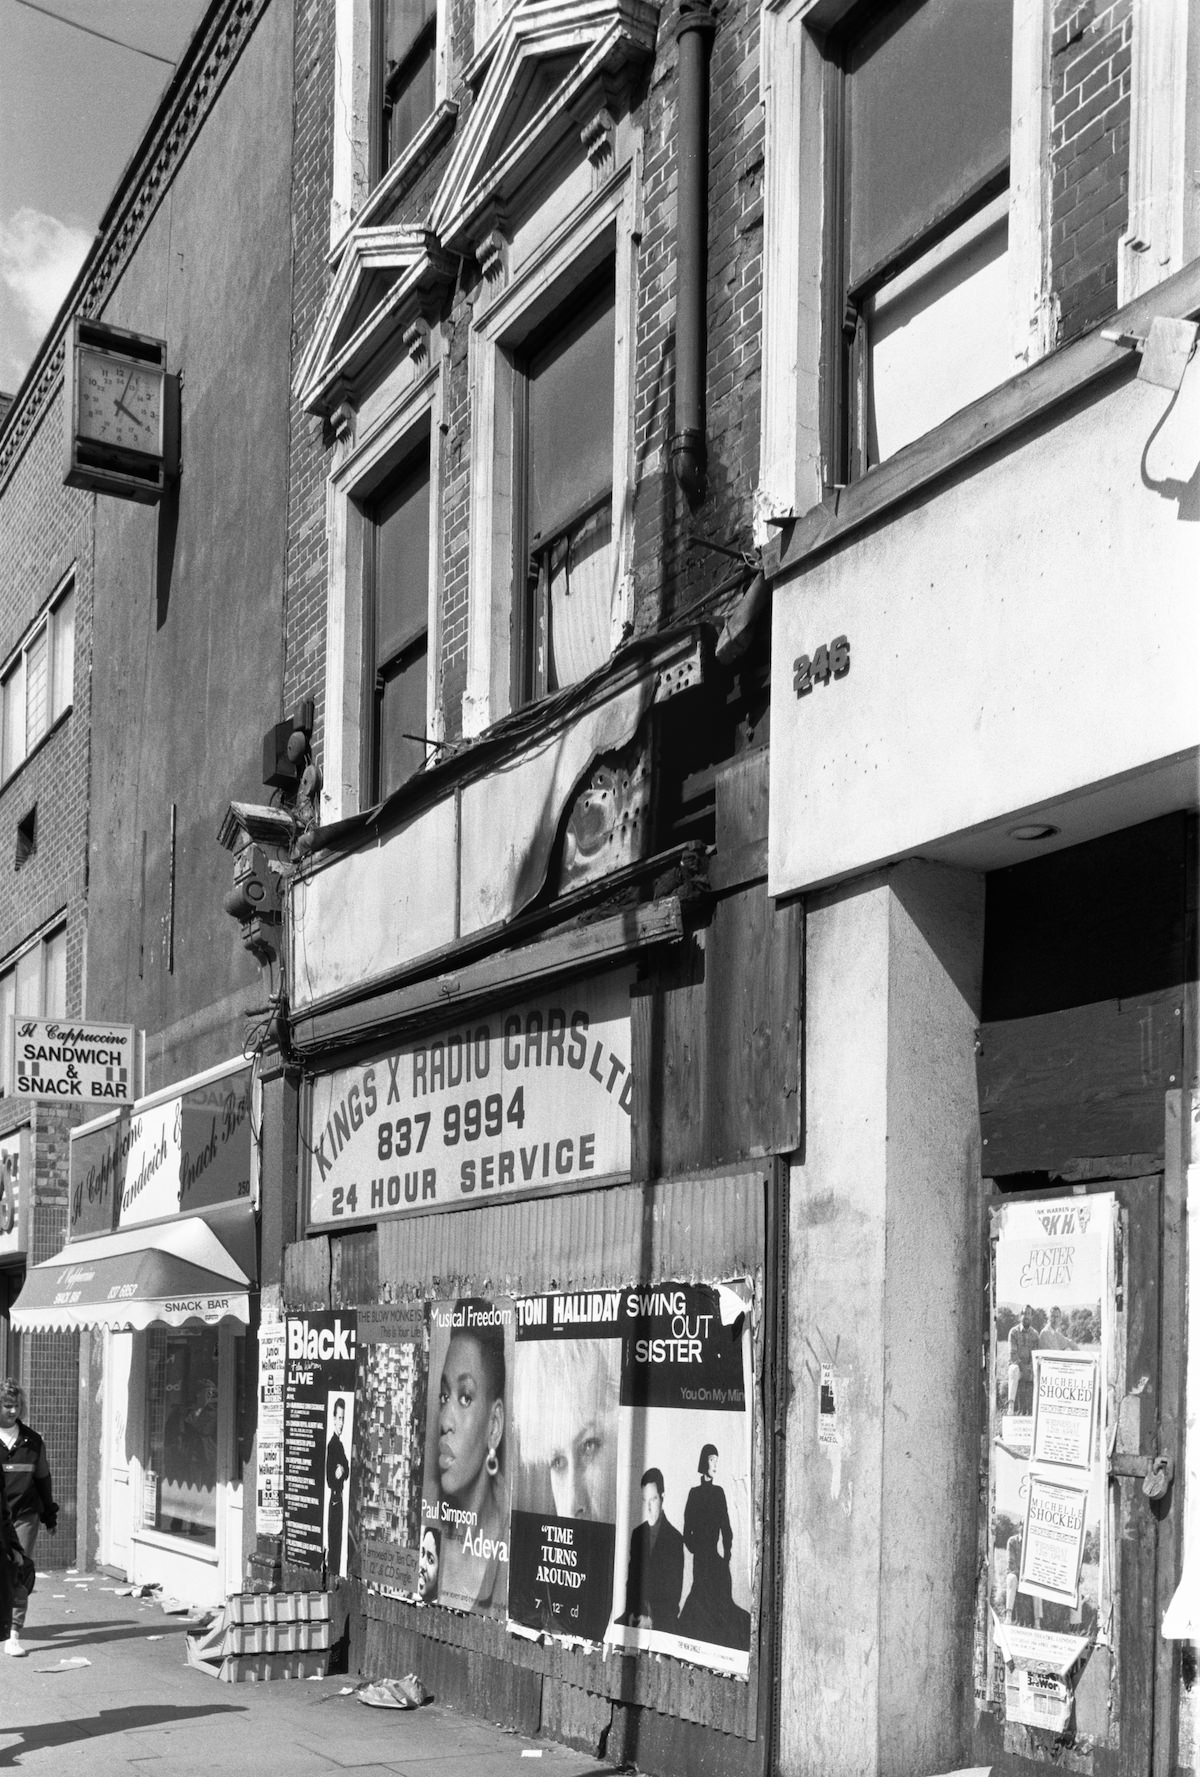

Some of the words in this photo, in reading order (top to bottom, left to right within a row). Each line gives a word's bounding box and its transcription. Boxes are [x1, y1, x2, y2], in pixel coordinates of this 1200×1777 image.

[45, 1024, 128, 1046] Cappuccino
[23, 1044, 121, 1066] SANDWICH
[66, 1064, 79, 1080] &
[17, 1076, 82, 1096] SNACK
[91, 1081, 128, 1099] BAR
[313, 1068, 377, 1183] KINGS
[387, 1052, 401, 1106] X
[413, 1024, 491, 1098] RADIO
[504, 1008, 590, 1071] CARS
[589, 1040, 632, 1116] LTD
[378, 1112, 431, 1161] 837
[443, 1085, 525, 1147] 9994
[117, 1122, 168, 1212] Sandwich
[177, 1115, 218, 1202] Snack
[332, 1183, 358, 1216] 24
[371, 1167, 437, 1209] HOUR
[460, 1132, 596, 1193] SERVICE
[1029, 1246, 1075, 1267] FOSTER
[1032, 1265, 1072, 1286] ALLEN
[164, 1301, 203, 1313] SNACK
[207, 1299, 229, 1310] BAR
[516, 1297, 548, 1327] TONI
[553, 1292, 622, 1323] HALLIDAY
[626, 1291, 686, 1317] SWING
[431, 1307, 466, 1329] Musical
[468, 1307, 512, 1328] Freedom
[671, 1315, 713, 1339] OUT
[287, 1319, 356, 1360] Black:
[635, 1339, 703, 1363] SISTER
[288, 1371, 314, 1385] LIVE
[1041, 1376, 1093, 1390] MICHELLE
[680, 1386, 697, 1401] You
[698, 1387, 712, 1401] On
[713, 1388, 727, 1404] My
[728, 1389, 744, 1402] Min
[1039, 1385, 1092, 1402] SHOCKED
[421, 1498, 439, 1520] Paul
[441, 1501, 478, 1529] Simpson
[1032, 1497, 1083, 1518] MICHELLE
[1030, 1507, 1081, 1531] SHOCKED
[462, 1526, 509, 1562] Adeva
[541, 1545, 577, 1567] TURNS
[570, 1604, 579, 1618] cd
